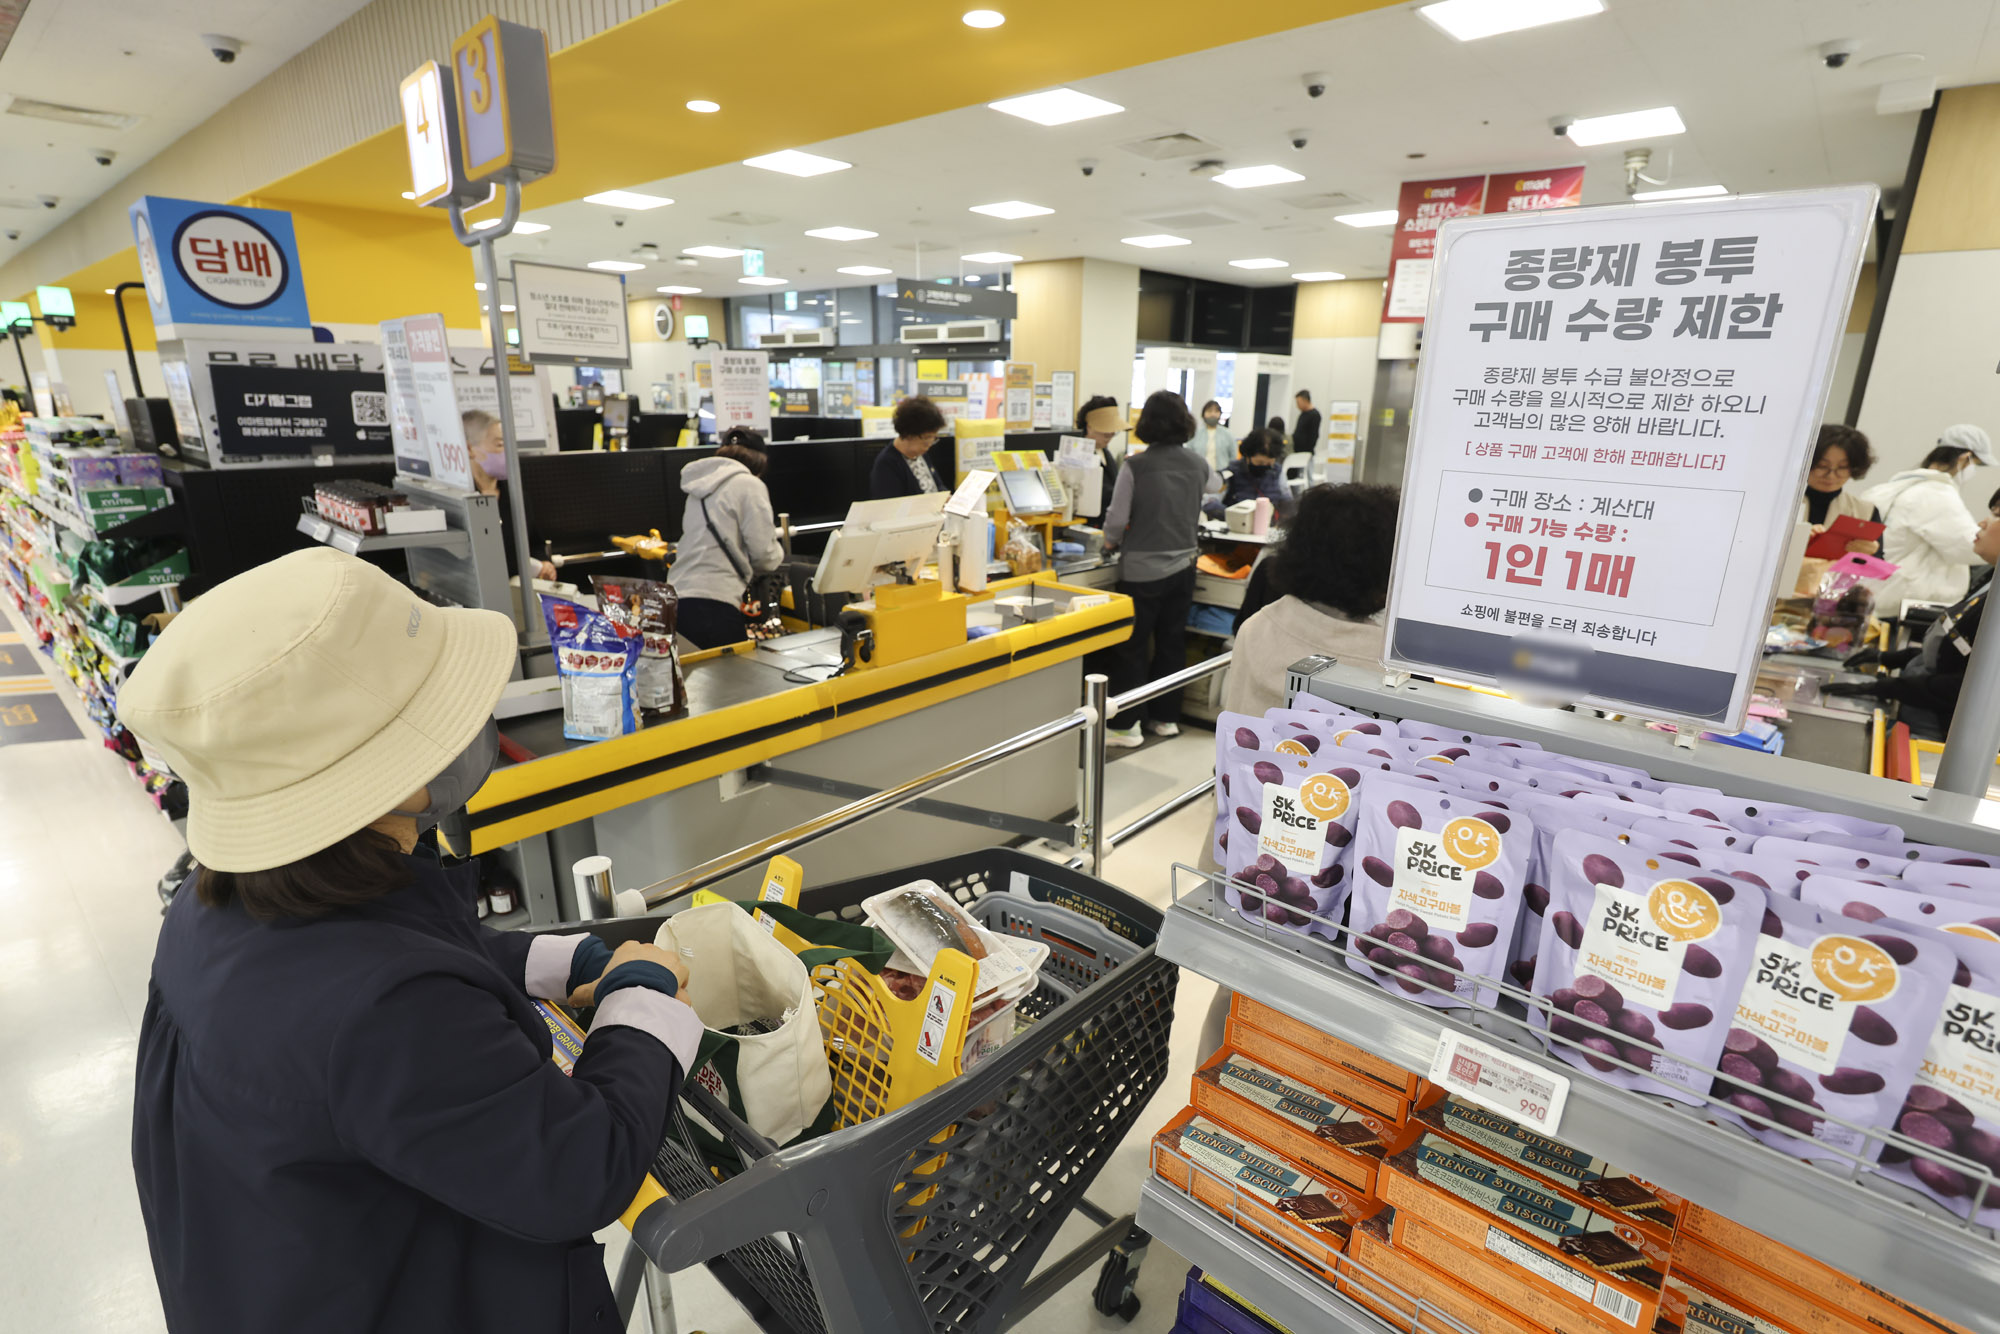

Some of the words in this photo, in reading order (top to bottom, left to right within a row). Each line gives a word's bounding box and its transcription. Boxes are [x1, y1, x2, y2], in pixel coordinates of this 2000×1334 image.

[466, 36, 492, 114] 3
[416, 79, 430, 144] 4
[1515, 177, 1552, 193] emart
[189, 237, 272, 278] 담배
[1504, 243, 1640, 291] 종량제
[1655, 236, 1758, 285] 봉투
[206, 275, 266, 288] CIGARETTES
[1468, 300, 1553, 342] 구매
[1566, 297, 1663, 341] 수량
[1673, 293, 1783, 339] 제한
[1483, 367, 1536, 385] 종량제
[1541, 367, 1578, 386] 봉투
[1584, 368, 1623, 386] 수급
[1629, 368, 1735, 388] 불안정으로
[1452, 389, 1486, 407] 구매
[1490, 390, 1543, 408] 수량을
[1550, 391, 1645, 411] 일시적으로
[1651, 393, 1694, 413] 제한
[1700, 394, 1767, 415] 하오니
[1474, 412, 1543, 431] 고객님의
[1549, 414, 1586, 432] 많은
[1592, 415, 1631, 435] 양해
[1637, 417, 1725, 439] 바랍니다.
[436, 441, 466, 473] 1,990
[1475, 442, 1504, 458] 상품
[1507, 444, 1538, 459] 구매
[1541, 446, 1588, 463] 고객에
[1593, 448, 1626, 465] 한해
[1630, 450, 1726, 471] 판매합니다]
[1490, 488, 1528, 509] 구매
[1533, 492, 1573, 512] 장소
[1590, 497, 1655, 520] 계산대
[1485, 513, 1524, 534] 구매
[1528, 517, 1568, 538] 가능
[1484, 541, 1548, 587] 1인
[1565, 550, 1636, 599] 1매
[1460, 603, 1500, 621] 쇼핑에
[1504, 609, 1544, 628] 불편을
[1548, 616, 1577, 634] 드려
[1581, 621, 1657, 646] 죄송합니다
[1273, 796, 1295, 812] 5K
[1313, 782, 1341, 800] OK
[1263, 836, 1316, 860] 자색고구마볼
[1408, 841, 1436, 859] 5K
[1458, 827, 1490, 847] OK
[1398, 889, 1461, 915] 자색고구마볼
[1606, 901, 1640, 923] 5K
[1667, 891, 1707, 916] OK
[1587, 952, 1667, 991] 자색고구마볼
[1760, 952, 1801, 978] 5K
[1835, 945, 1883, 978] OK
[1736, 1005, 1828, 1053] 자색고구마볼
[1946, 1003, 1995, 1030] 5K
[556, 1032, 583, 1057] GRAND
[698, 1064, 722, 1091] DER
[1228, 1066, 1273, 1089] FRENCH
[1276, 1085, 1320, 1109] BUTTER
[1280, 1101, 1327, 1124] BISCUIT
[1520, 1099, 1546, 1121] 990
[1451, 1105, 1510, 1134] FRENCH
[1514, 1129, 1574, 1159] BUTTER
[1189, 1129, 1237, 1155] FRENCH
[1238, 1151, 1284, 1178] BUTTER
[1525, 1150, 1587, 1179] BISCUIT
[1240, 1170, 1290, 1196] BISCUIT
[1425, 1150, 1488, 1181] FRENCH
[1492, 1177, 1555, 1210] BUTTER
[1503, 1201, 1568, 1233] BISCUIT
[1686, 1304, 1745, 1334] RENCH
